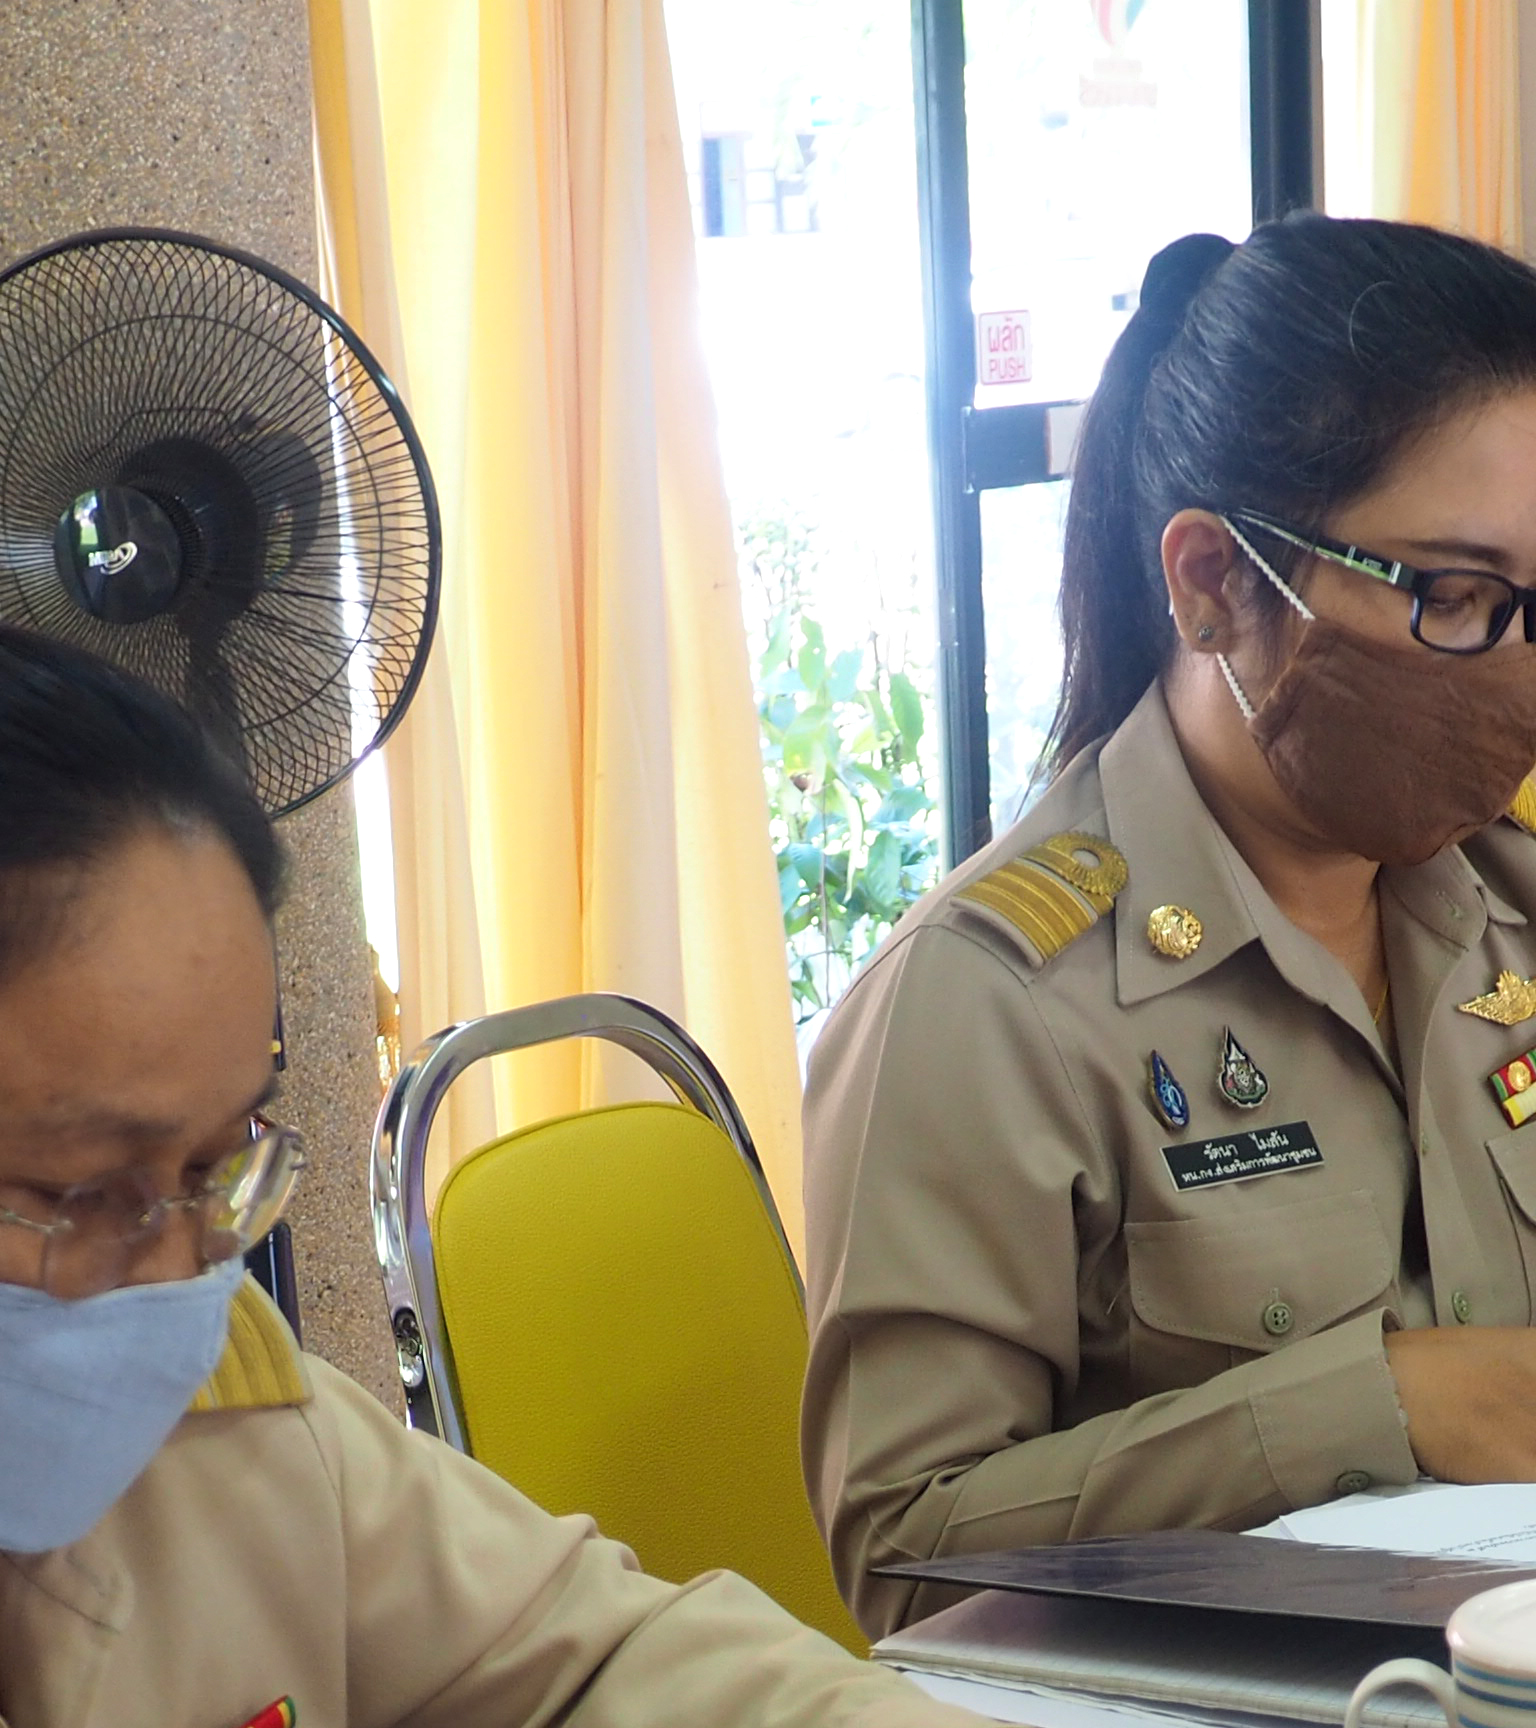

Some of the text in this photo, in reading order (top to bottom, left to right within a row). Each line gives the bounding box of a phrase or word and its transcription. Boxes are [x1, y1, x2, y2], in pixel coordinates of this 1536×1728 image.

[988, 317, 1025, 352] ผลัก
[989, 357, 1025, 379] PUSH
[1203, 1142, 1239, 1161] รัตนา
